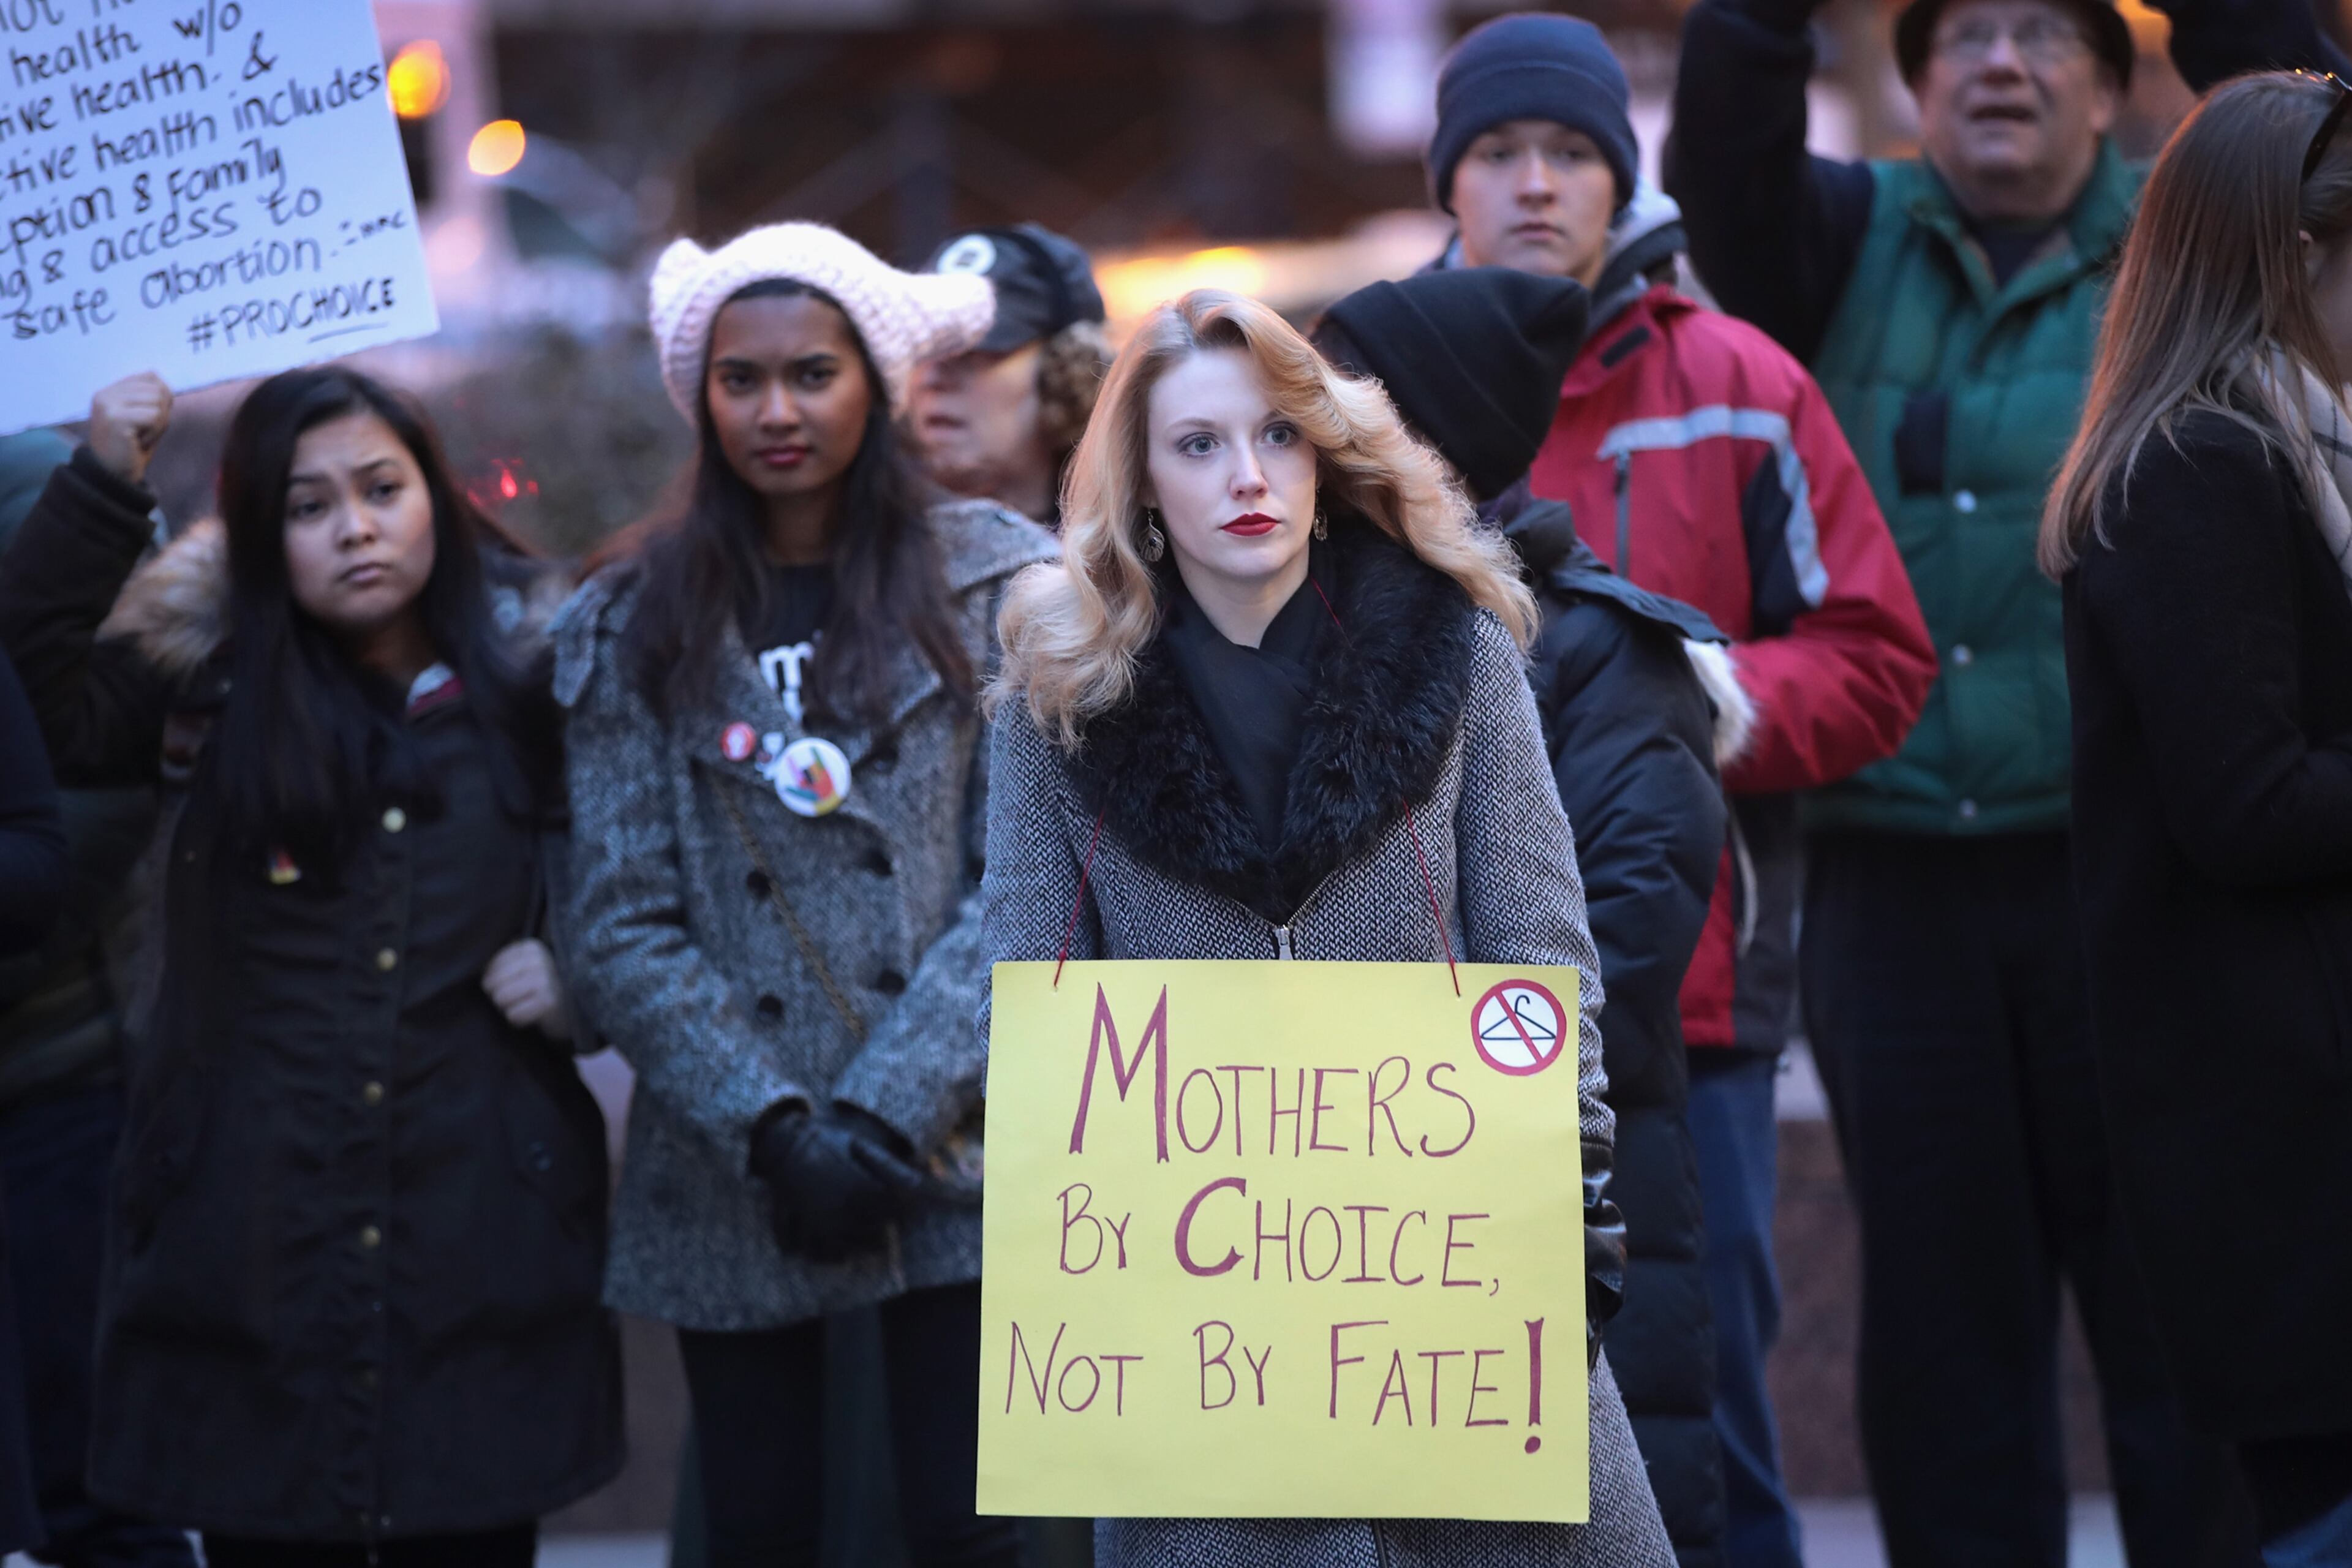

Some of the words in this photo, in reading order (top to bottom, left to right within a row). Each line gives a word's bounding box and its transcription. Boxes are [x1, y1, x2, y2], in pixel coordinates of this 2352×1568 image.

[10, 23, 141, 88] health
[172, 1, 242, 56] w/o
[242, 29, 278, 81] &
[0, 144, 77, 193] tive
[92, 110, 216, 173] health
[228, 63, 381, 131] includes
[0, 186, 115, 265] ption
[90, 201, 239, 273] access
[257, 187, 322, 227] to
[12, 287, 116, 339] safe
[186, 277, 395, 353] #PROCHOICE
[1069, 981, 1476, 1163] MOTHERS
[1057, 1183, 1131, 1274] BY
[1174, 1177, 1500, 1296] CHOICE,
[1006, 1322, 1144, 1416] NOT
[1193, 1321, 1272, 1410] BY
[1329, 1317, 1545, 1454] FATE!
